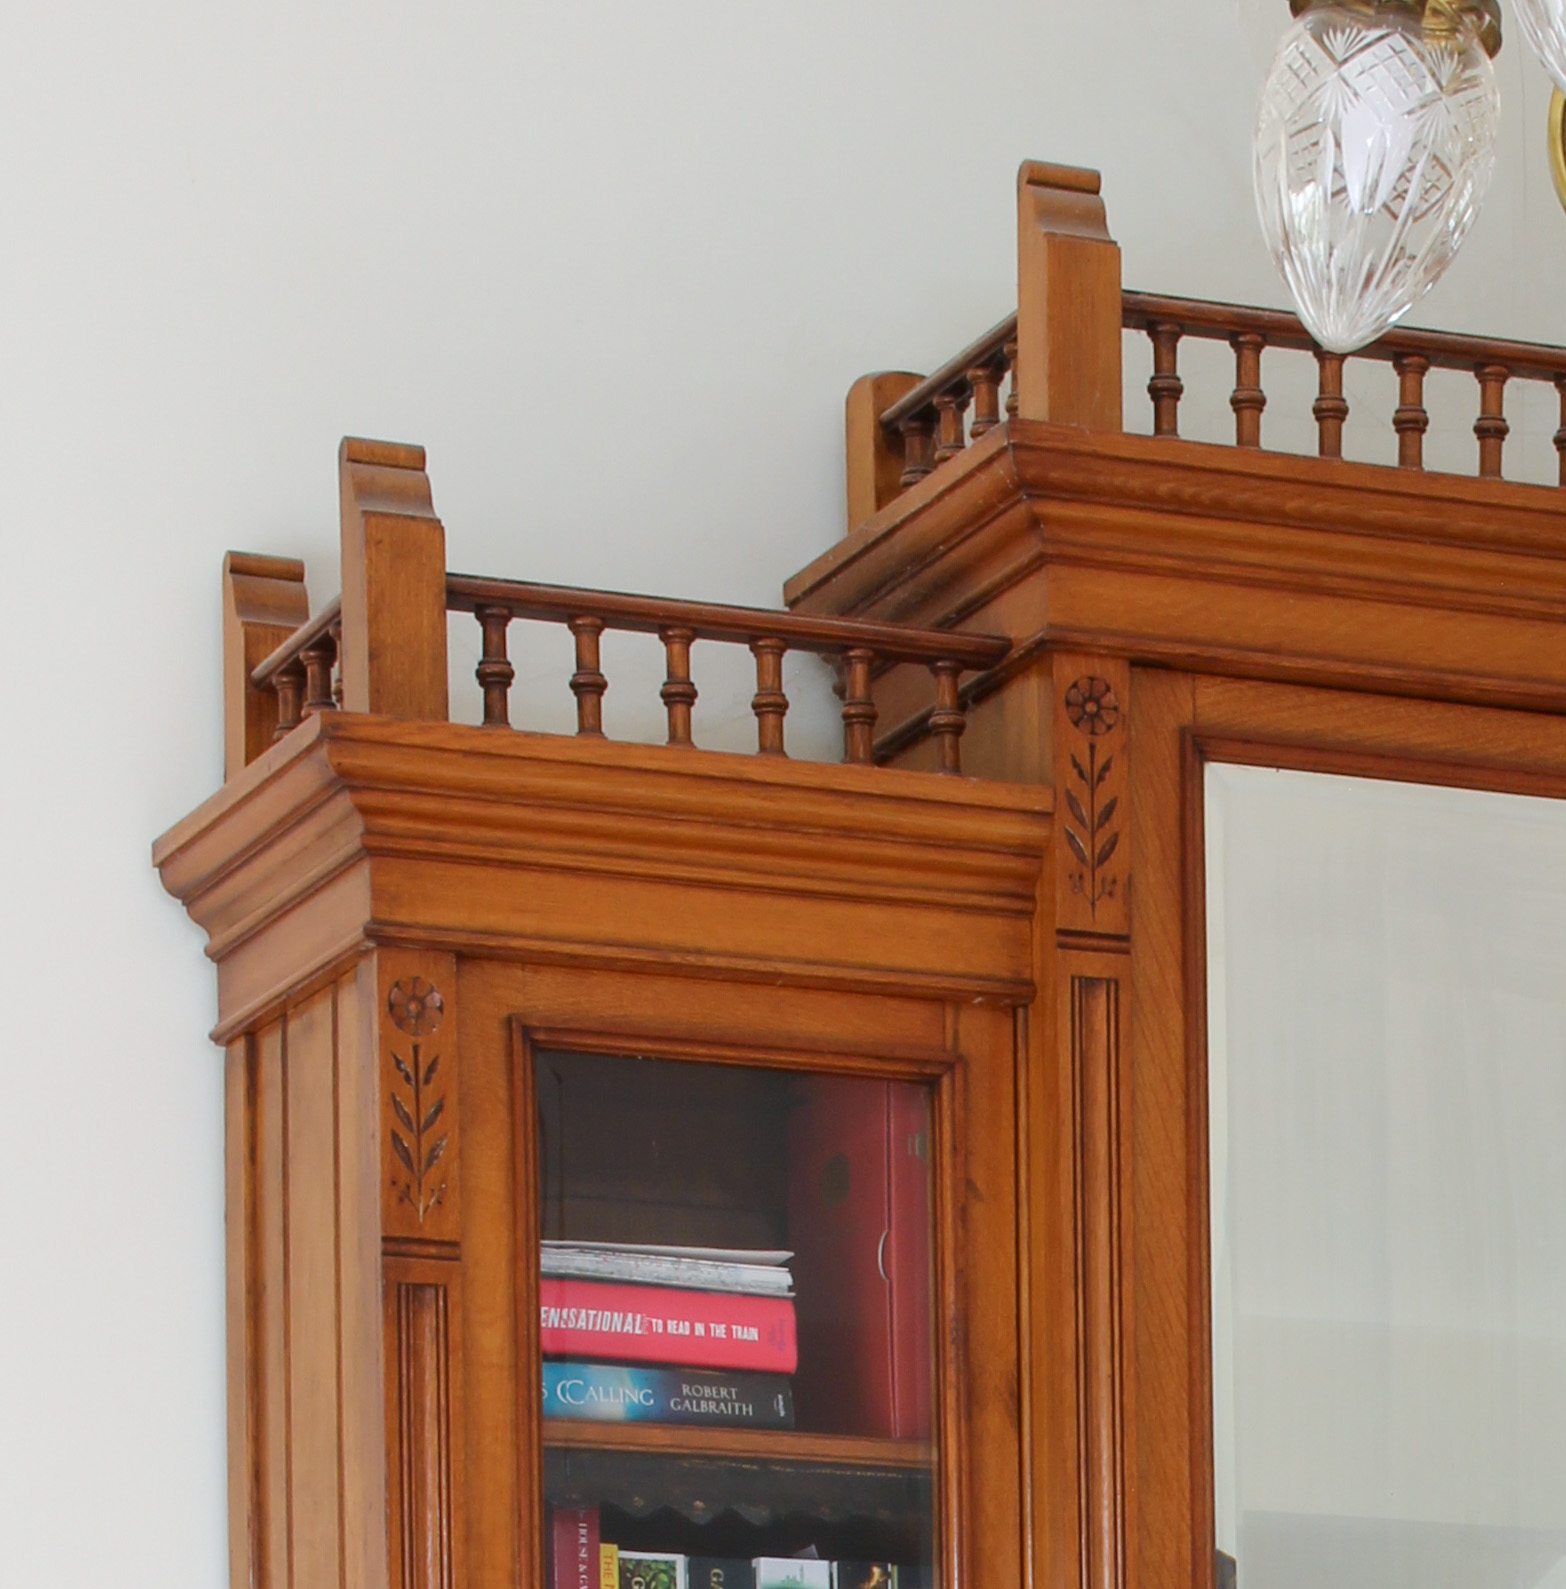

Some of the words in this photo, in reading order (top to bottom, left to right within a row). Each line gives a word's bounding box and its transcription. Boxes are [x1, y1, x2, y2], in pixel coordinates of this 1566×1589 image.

[651, 1318, 663, 1332] TO
[667, 1319, 690, 1336] READ
[710, 1323, 727, 1338] THE
[682, 1384, 737, 1399] ROBERT
[670, 1398, 753, 1416] GALBRAITH
[603, 1554, 614, 1579] THE
